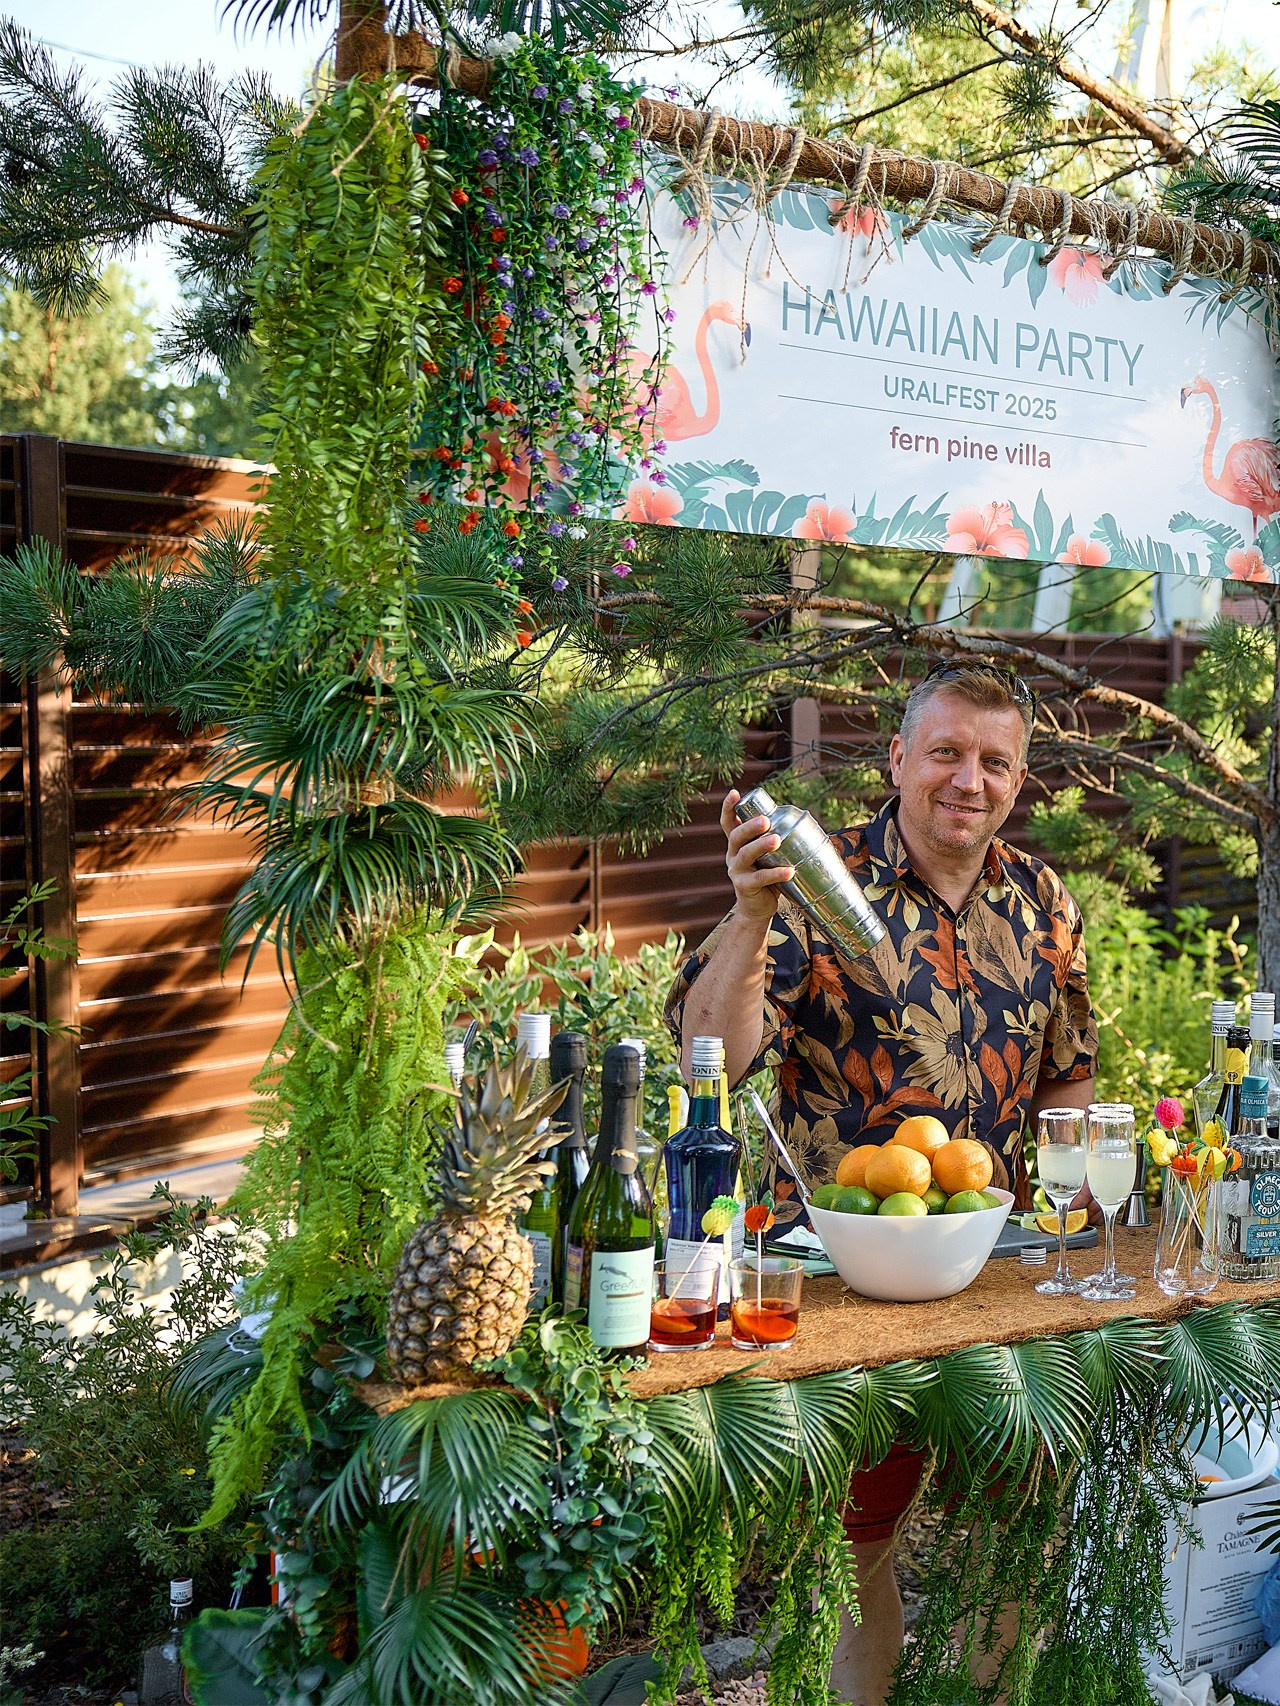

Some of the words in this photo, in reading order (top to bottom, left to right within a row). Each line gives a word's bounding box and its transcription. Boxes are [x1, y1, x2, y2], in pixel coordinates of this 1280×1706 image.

[782, 281, 999, 364] HAWAIIAN
[1015, 322, 1145, 386] PARTY
[884, 375, 1000, 412] URALFEST
[1004, 393, 1058, 421] 2025
[889, 425, 940, 455] fern
[947, 435, 999, 462] pine
[1005, 442, 1052, 469] villa
[1256, 1230, 1277, 1238] SILVER
